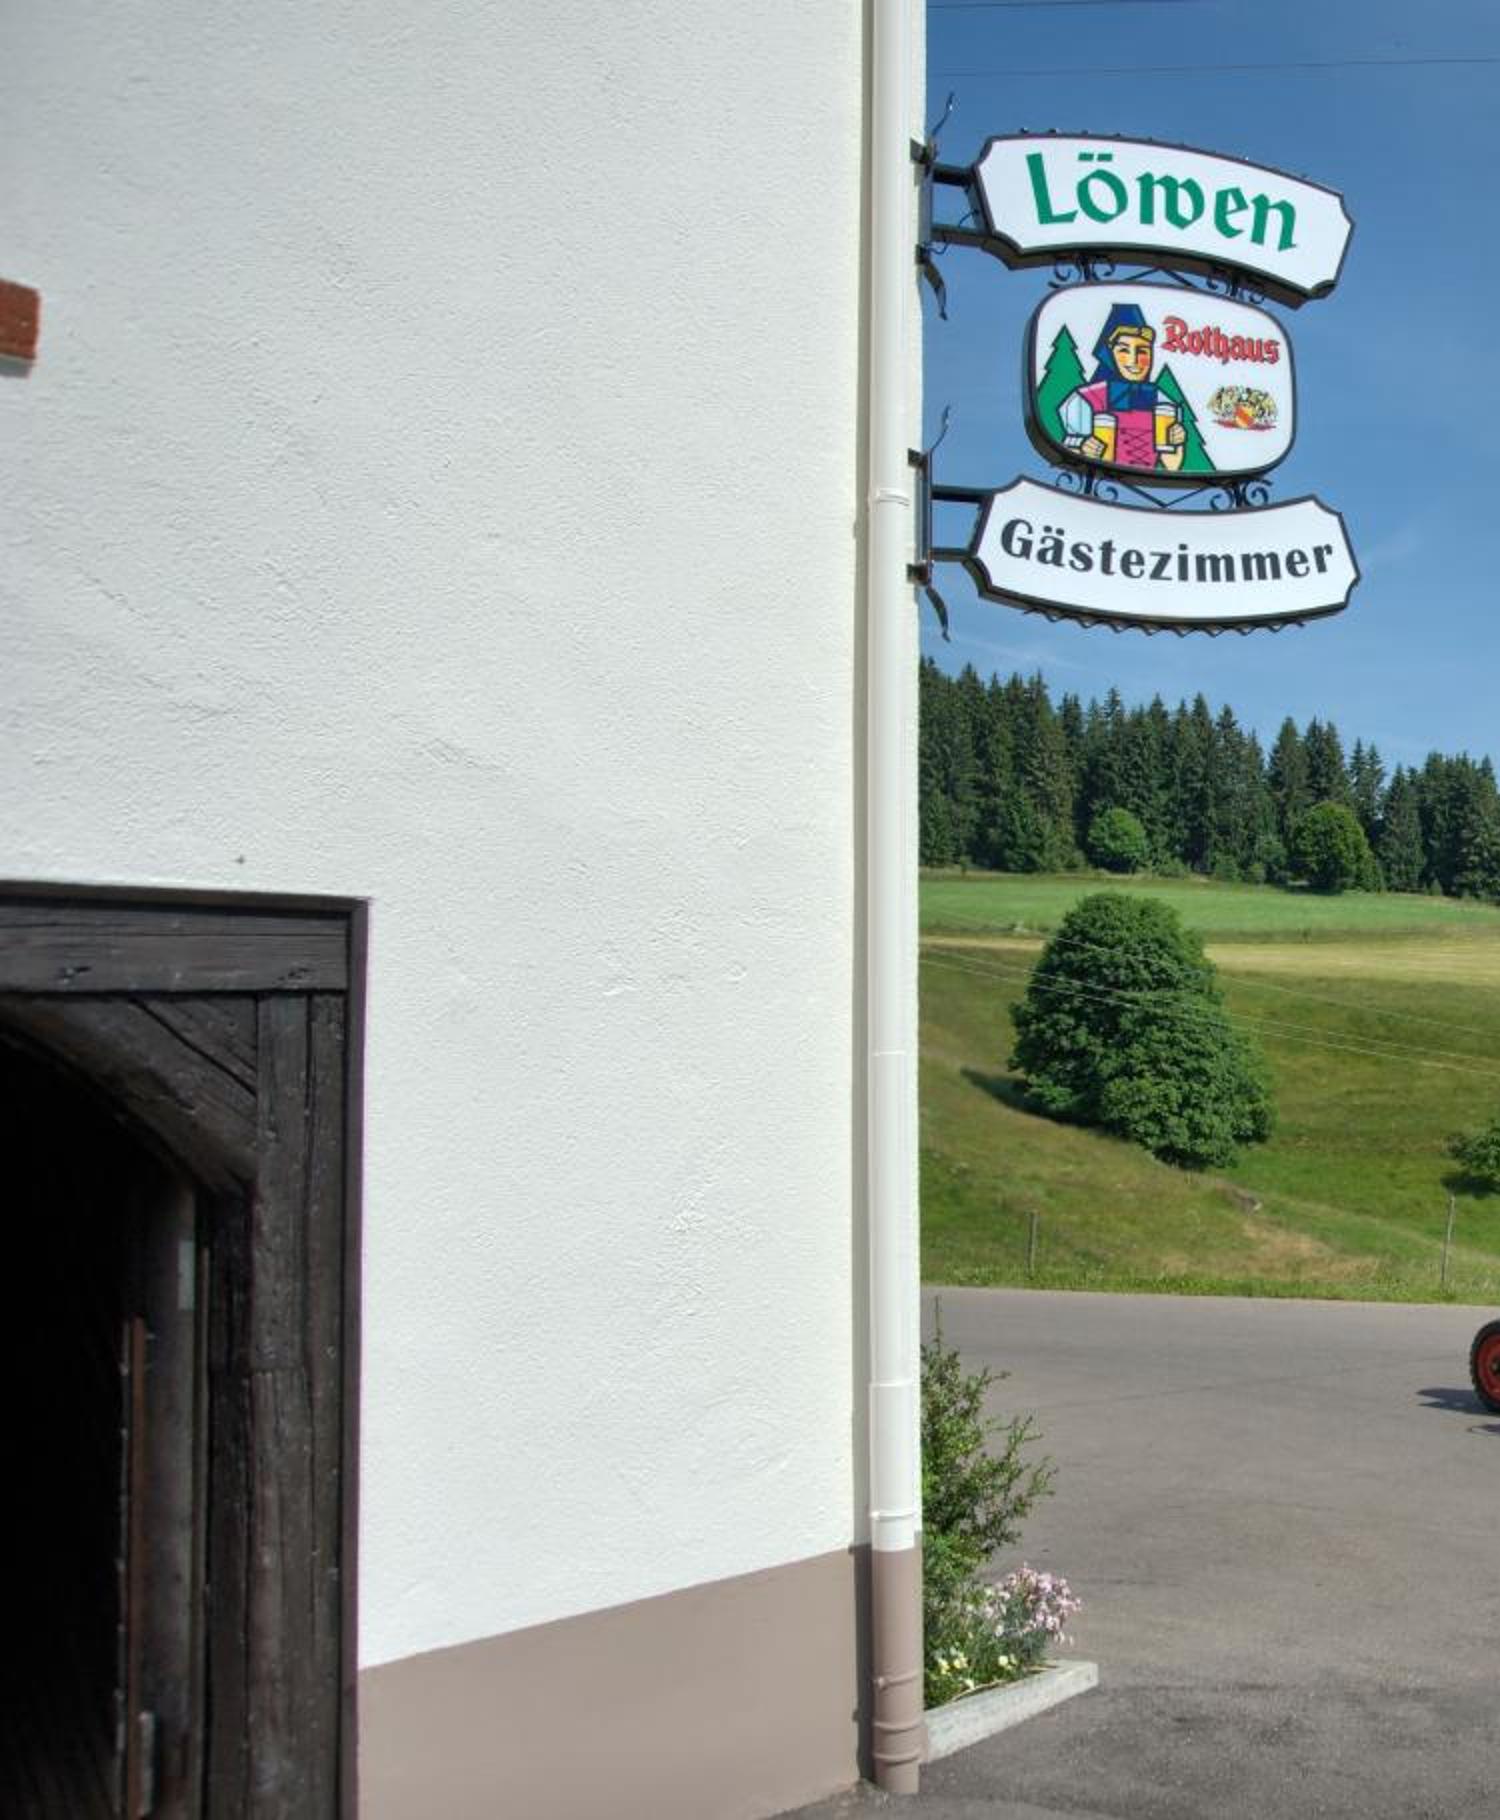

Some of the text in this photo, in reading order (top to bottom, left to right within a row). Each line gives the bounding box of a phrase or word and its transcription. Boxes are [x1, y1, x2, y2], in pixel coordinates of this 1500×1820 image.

[1026, 152, 1298, 250] Löwen
[1161, 315, 1279, 364] Rothaus
[1000, 518, 1333, 582] Gästezimmer
